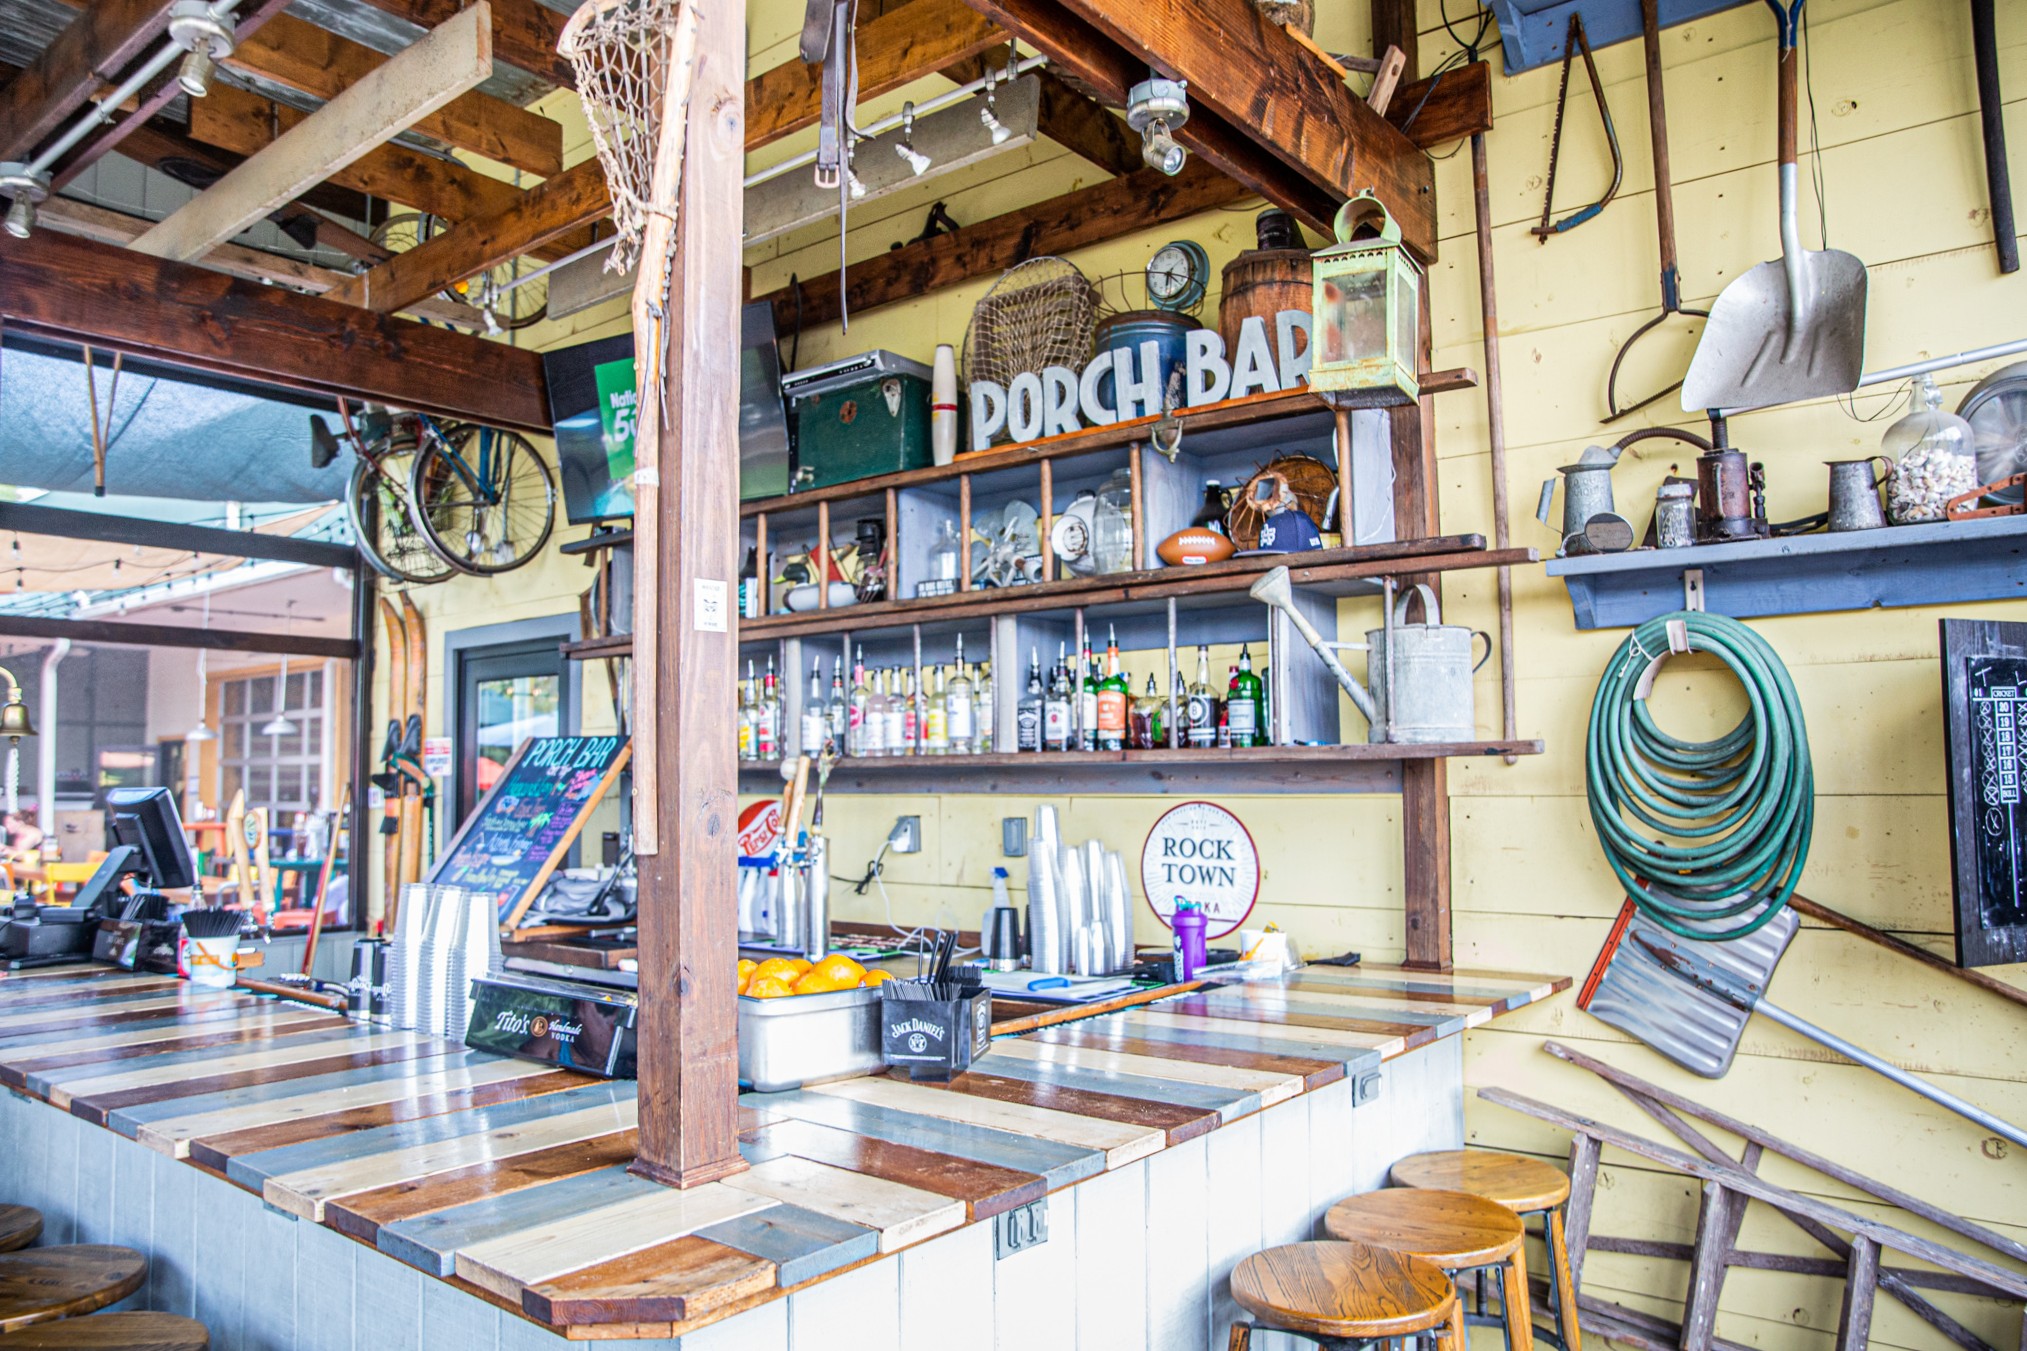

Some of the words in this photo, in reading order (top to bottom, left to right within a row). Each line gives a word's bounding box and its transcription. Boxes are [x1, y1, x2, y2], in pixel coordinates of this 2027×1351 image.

[971, 340, 1164, 452] PORCH
[1185, 309, 1314, 408] BAR
[1993, 690, 2015, 698] CRICKET
[1998, 702, 2010, 713] 20
[1999, 717, 2010, 727] 19
[2000, 731, 2011, 742] 18
[522, 738, 584, 768] PORCH
[572, 737, 618, 768] BAR
[2001, 746, 2012, 756] 17
[2003, 760, 2014, 771] 16
[2003, 774, 2014, 784] 15
[2002, 788, 2017, 799] BULL
[1162, 837, 1235, 861] ROCK
[1161, 863, 1237, 888] TOWN
[494, 1011, 530, 1035] Tito's
[548, 1018, 583, 1036] Handmade
[891, 1021, 912, 1039] JACK
[912, 1018, 946, 1042] DANIEL'S
[551, 1032, 575, 1043] VODKA
